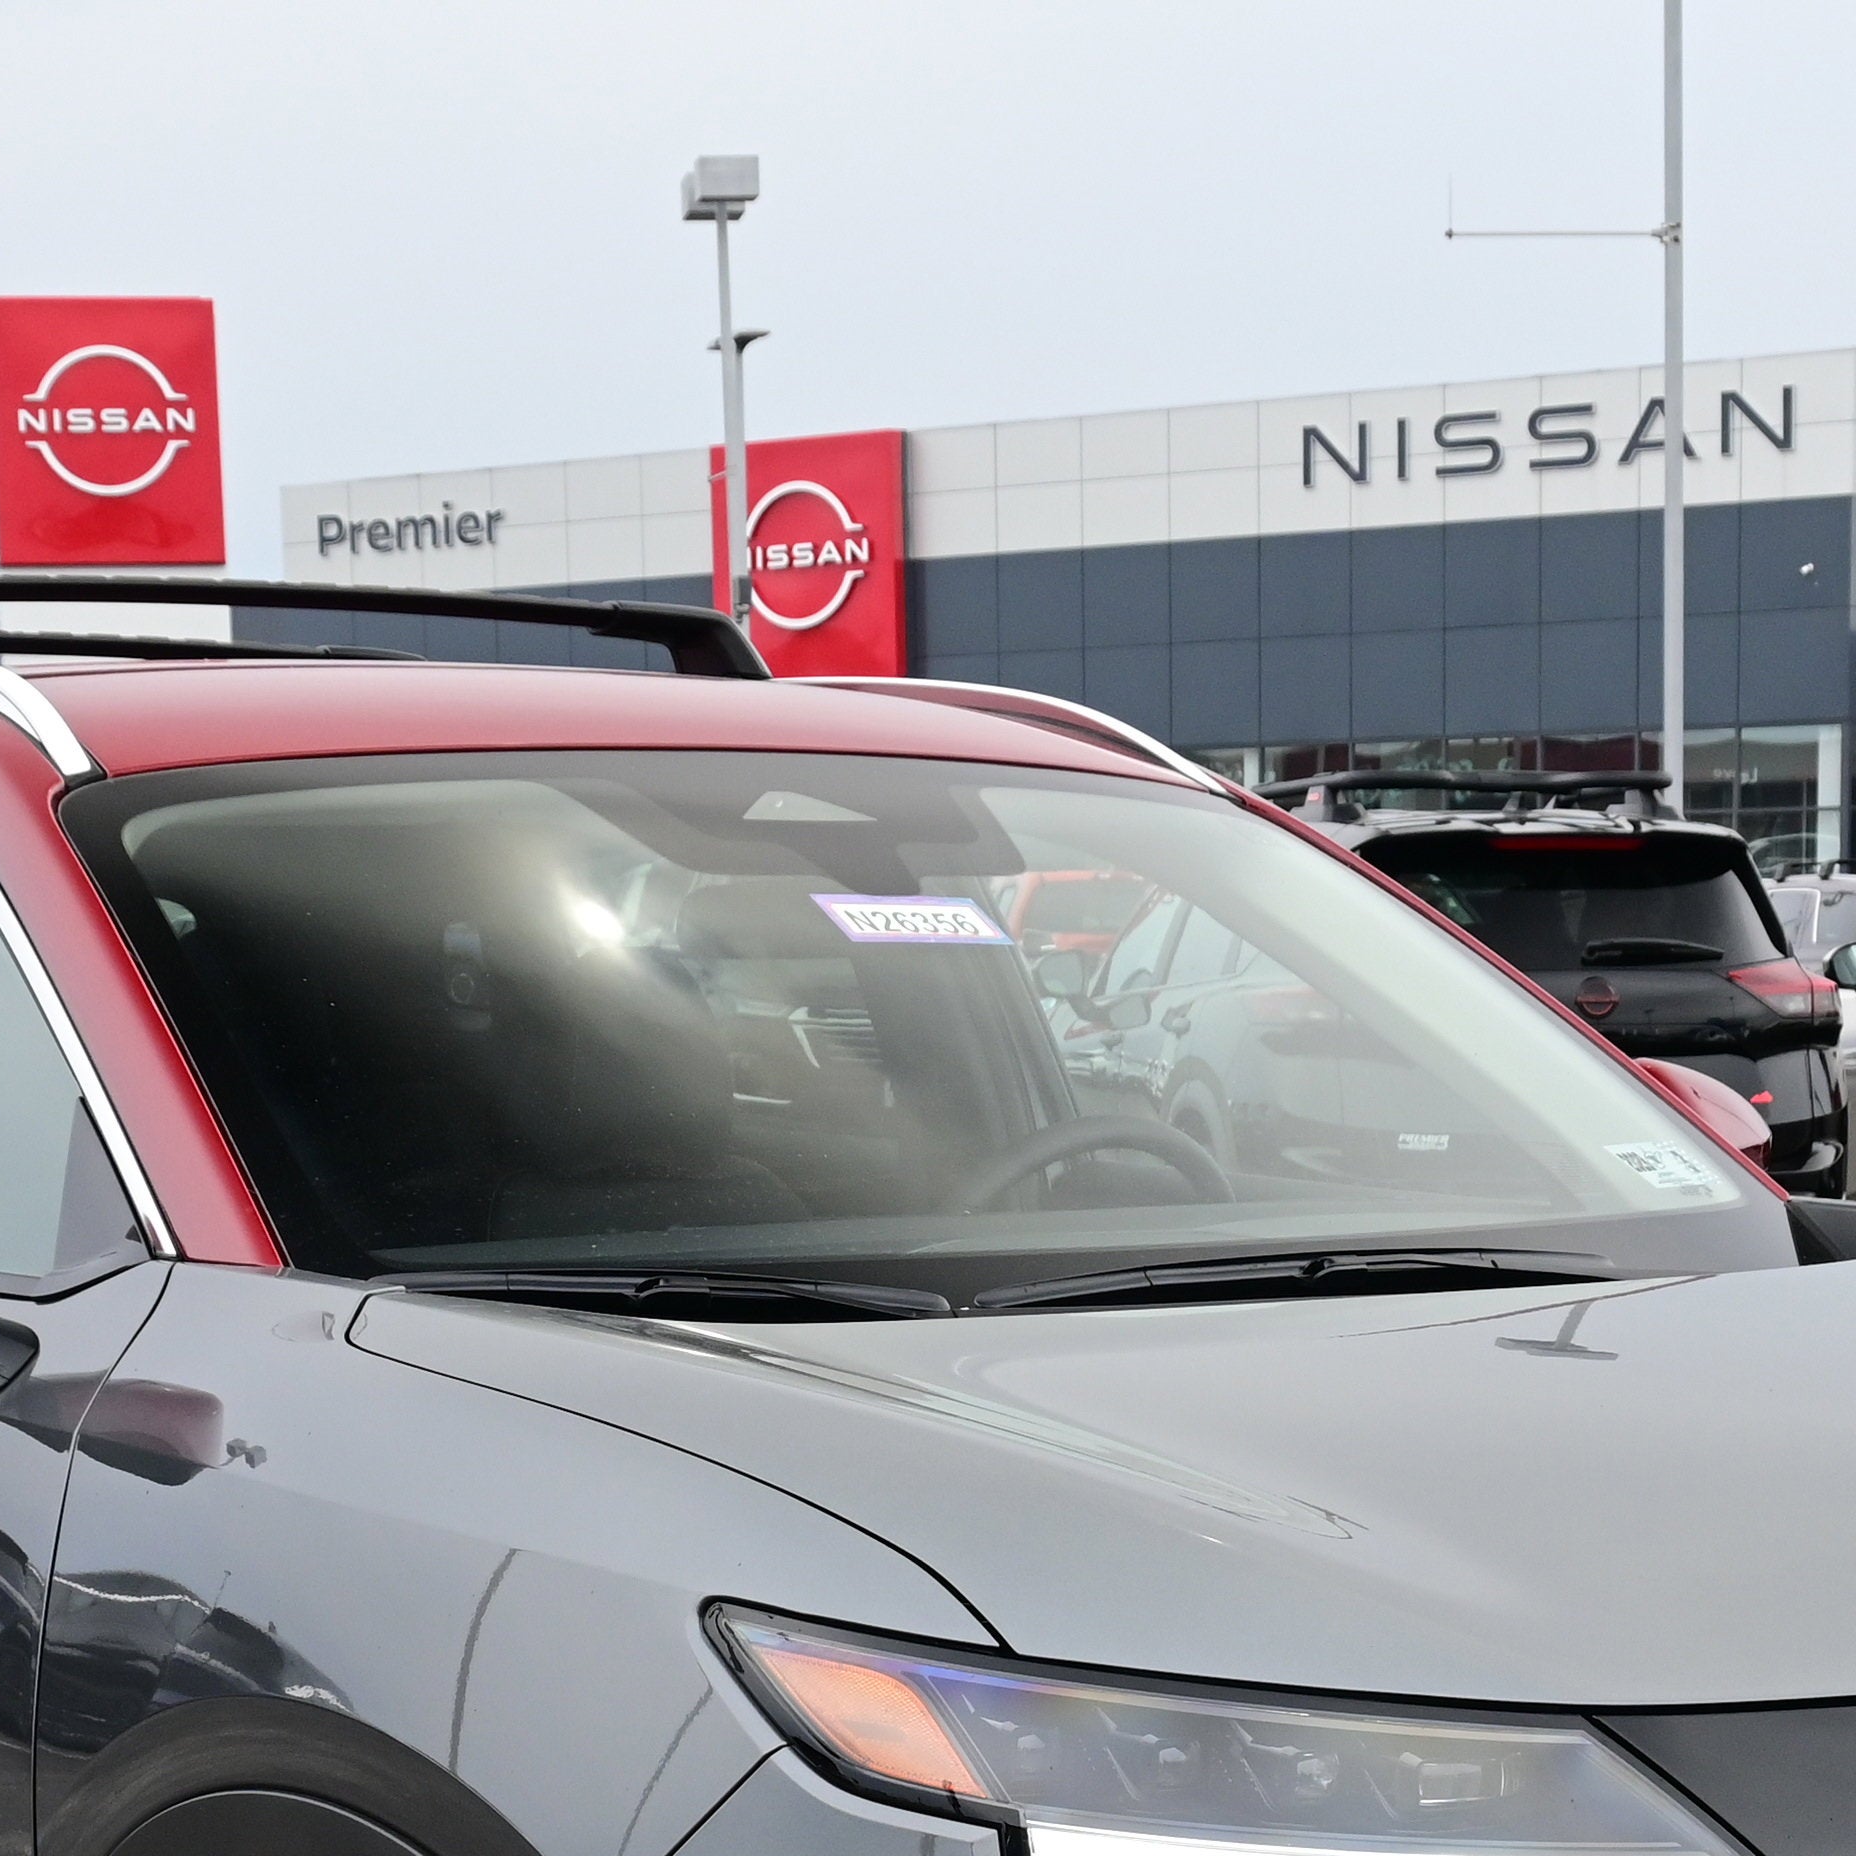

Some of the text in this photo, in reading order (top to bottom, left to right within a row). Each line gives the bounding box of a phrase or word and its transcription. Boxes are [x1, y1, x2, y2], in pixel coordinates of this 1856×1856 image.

[17, 405, 196, 434] NISSAN
[1301, 384, 1797, 488] NISSAN
[317, 501, 505, 557] Premier
[844, 909, 980, 936] N26356
